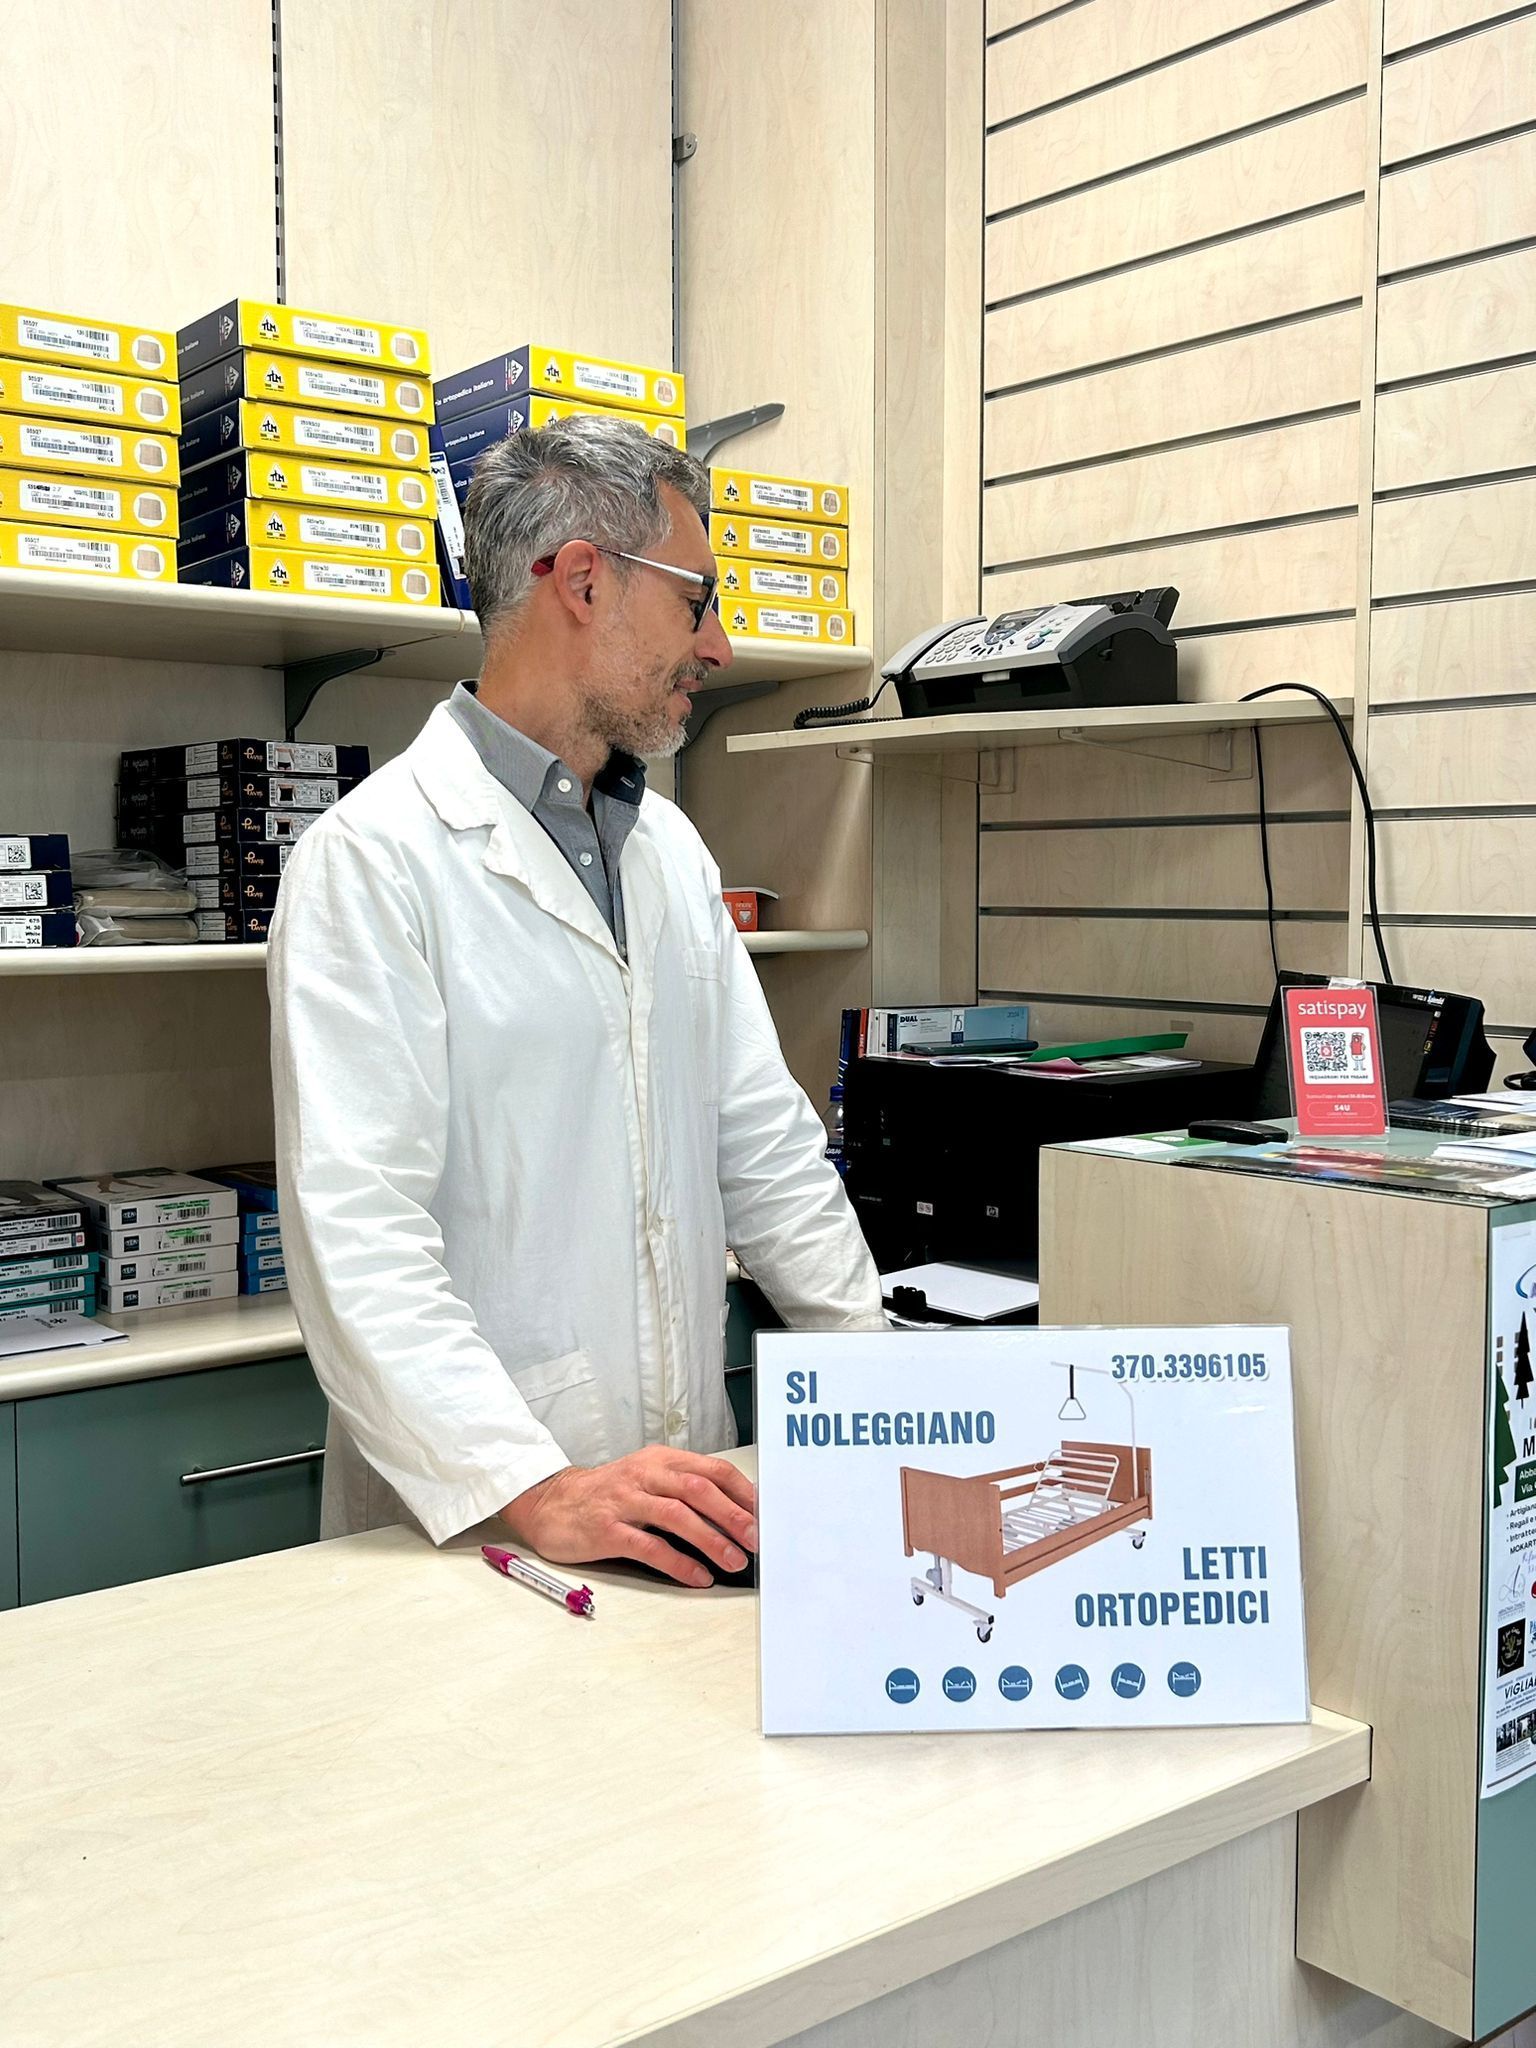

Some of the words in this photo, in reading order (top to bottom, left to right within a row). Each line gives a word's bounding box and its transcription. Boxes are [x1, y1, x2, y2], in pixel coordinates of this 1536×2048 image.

[900, 1015, 918, 1023] DUAL
[1298, 1000, 1367, 1019] satispay
[1111, 1353, 1267, 1383] 370.3396105
[786, 1371, 818, 1404] SI
[786, 1411, 996, 1447] NOLEGGIANO
[1521, 1484, 1533, 1494] Via
[1510, 1518, 1529, 1530] Regali
[1183, 1545, 1268, 1580] LETTI
[1074, 1590, 1270, 1627] ORTOPEDICI
